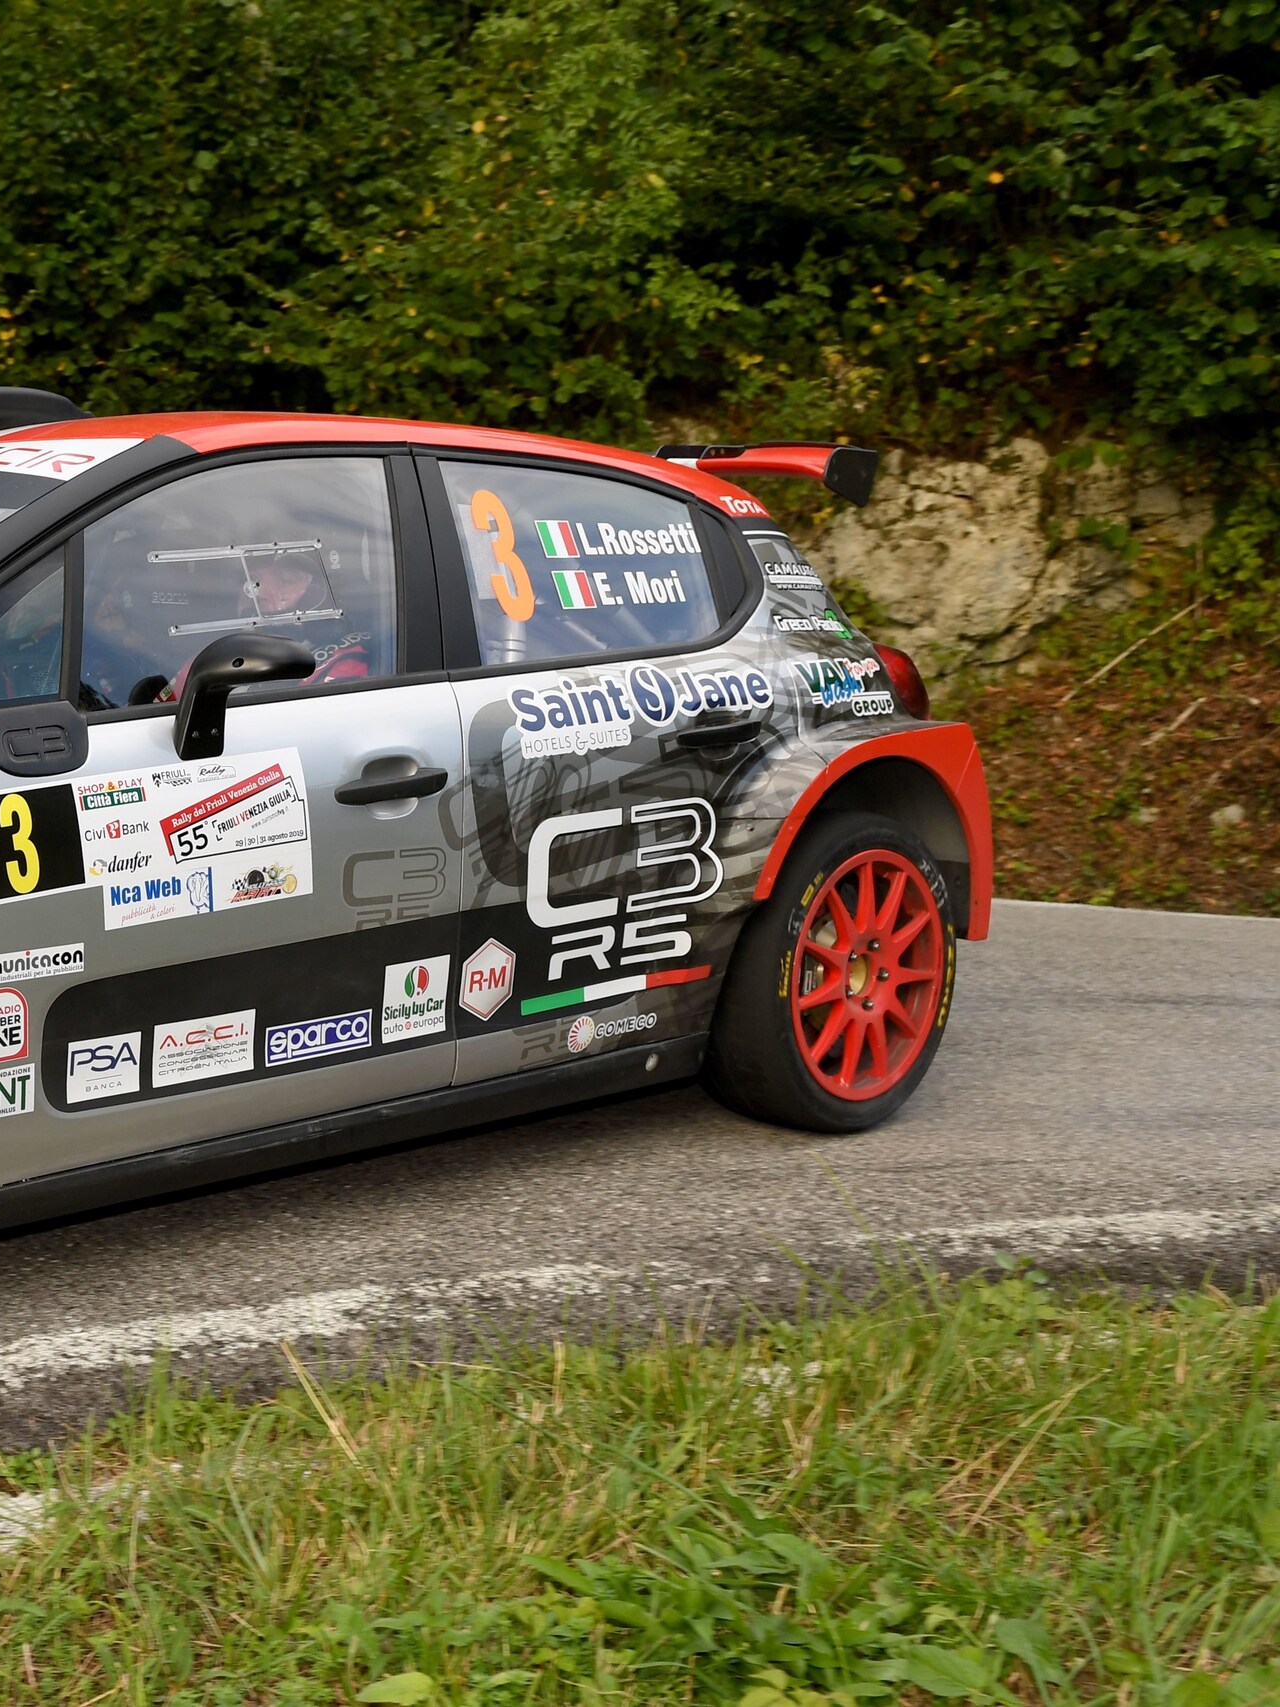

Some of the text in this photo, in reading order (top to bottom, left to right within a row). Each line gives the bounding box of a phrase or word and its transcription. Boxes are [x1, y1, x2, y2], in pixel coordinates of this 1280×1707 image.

[720, 496, 766, 514] TOTA
[575, 522, 702, 556] L.Rossetti
[471, 489, 535, 622] 3
[592, 570, 686, 606] E. Mori
[511, 671, 770, 733] Saint Jane
[854, 699, 892, 714] GROUP
[524, 735, 571, 754] HOTELS
[590, 728, 629, 747] SUITES
[161, 769, 187, 780] FRIULI
[199, 765, 226, 776] Rally
[77, 783, 105, 796] SHOP
[118, 777, 143, 789] PLAY
[86, 793, 111, 809] Città
[171, 770, 281, 829] Rally del Friuli Venezia Giulia
[217, 789, 291, 834] FRIULI VENEZIA GIULIA
[122, 819, 150, 837] Bank
[268, 832, 288, 843] agosto
[289, 829, 304, 838] 2019
[108, 851, 152, 874] danfer
[526, 796, 725, 928] C3
[110, 876, 181, 906] Nca Web
[548, 914, 692, 981] R5
[1, 971, 32, 982] industriali
[33, 970, 45, 978] per
[53, 964, 84, 975] pubblicità
[468, 965, 506, 993] R-M
[384, 998, 445, 1021] Sicily by Car
[384, 1016, 444, 1035] auto europa
[595, 1013, 657, 1039] COMECO
[270, 1016, 368, 1060] sparco
[70, 1042, 138, 1077] PSA
[159, 1048, 247, 1068] CONCESSIONARI
[160, 1041, 247, 1060] ASSOCIAZIONE
[215, 1056, 247, 1066] ITALIA
[86, 1081, 122, 1092] BANCA
